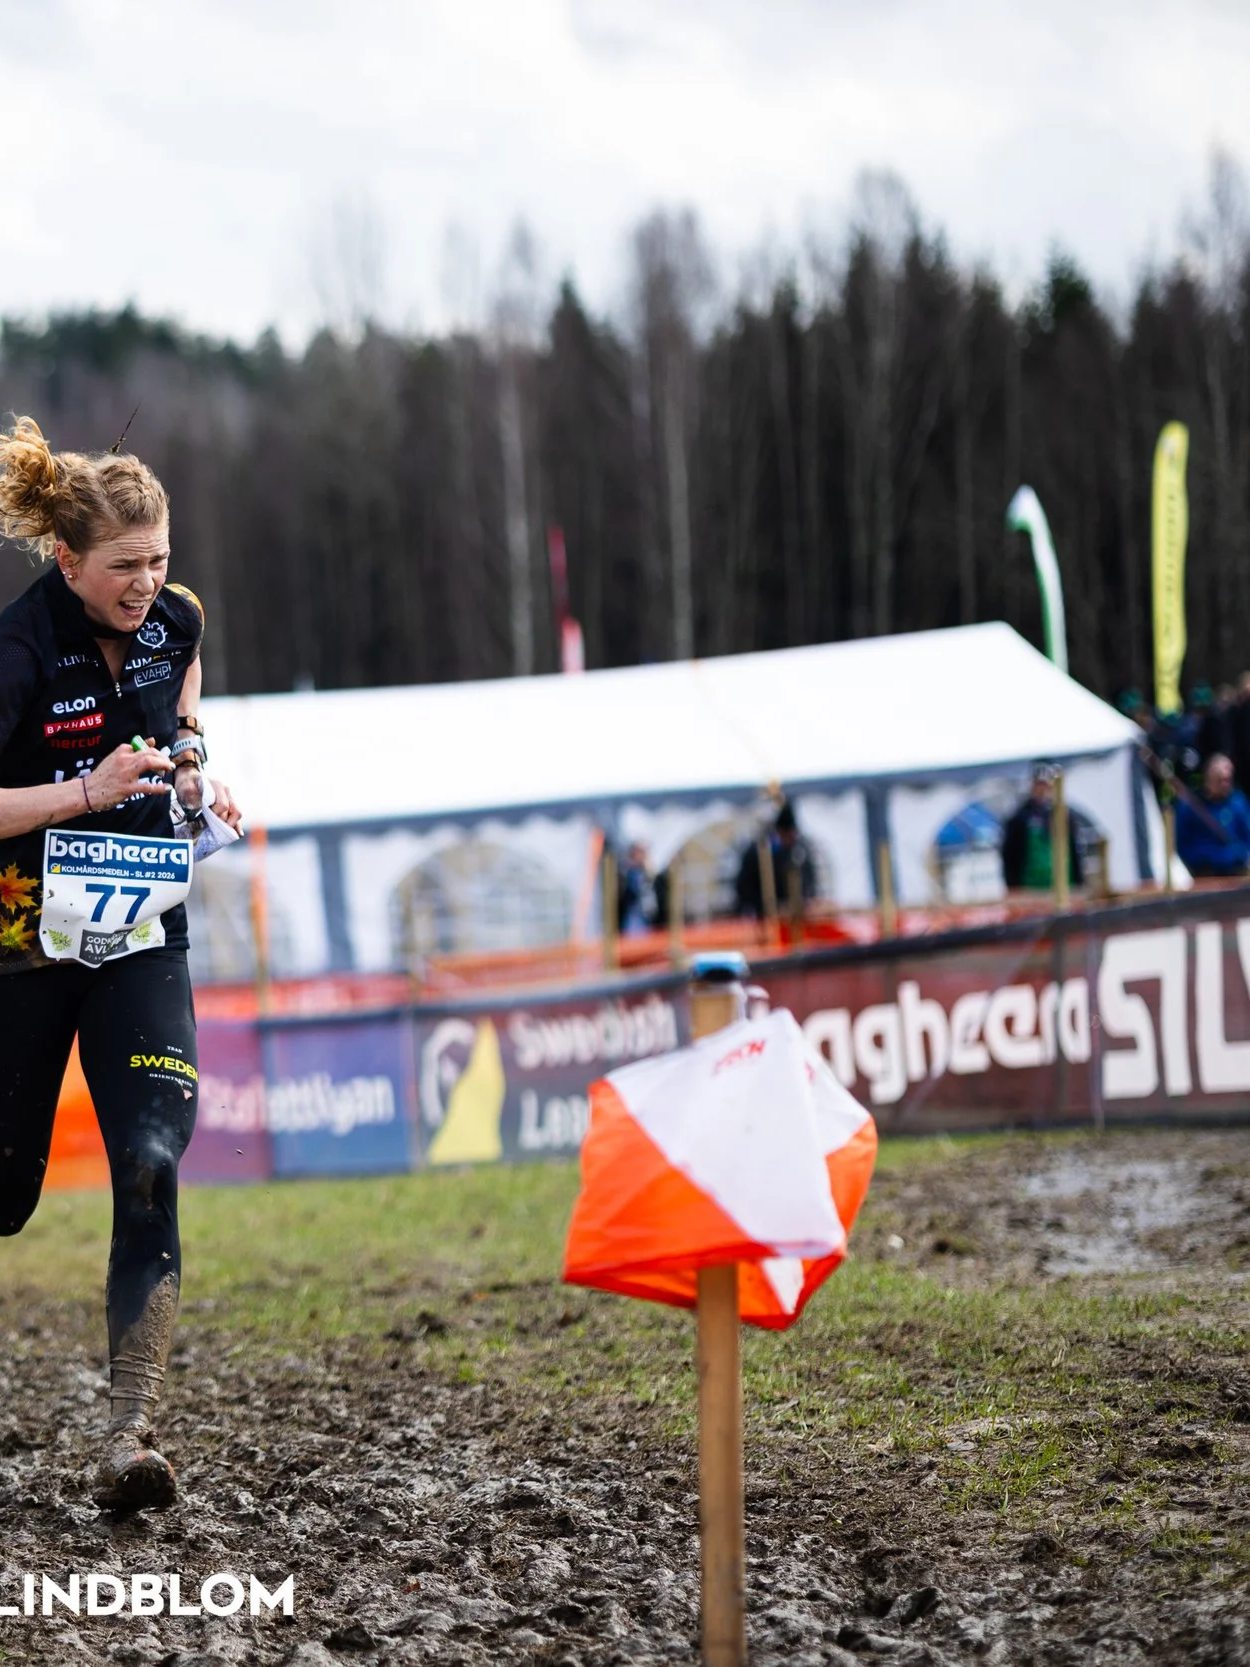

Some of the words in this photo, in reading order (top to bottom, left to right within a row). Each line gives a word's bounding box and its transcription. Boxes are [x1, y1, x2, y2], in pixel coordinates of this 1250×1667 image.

[46, 715, 102, 735] BAUHAUS
[50, 835, 188, 865] bagheera
[61, 864, 130, 877] KOLMÅRDSMEDELN
[135, 871, 144, 879] SL
[144, 871, 156, 880] #2
[157, 871, 176, 880] 2026
[85, 883, 151, 925] 77
[166, 1045, 183, 1054] TEAM
[795, 978, 1092, 1104] agheera
